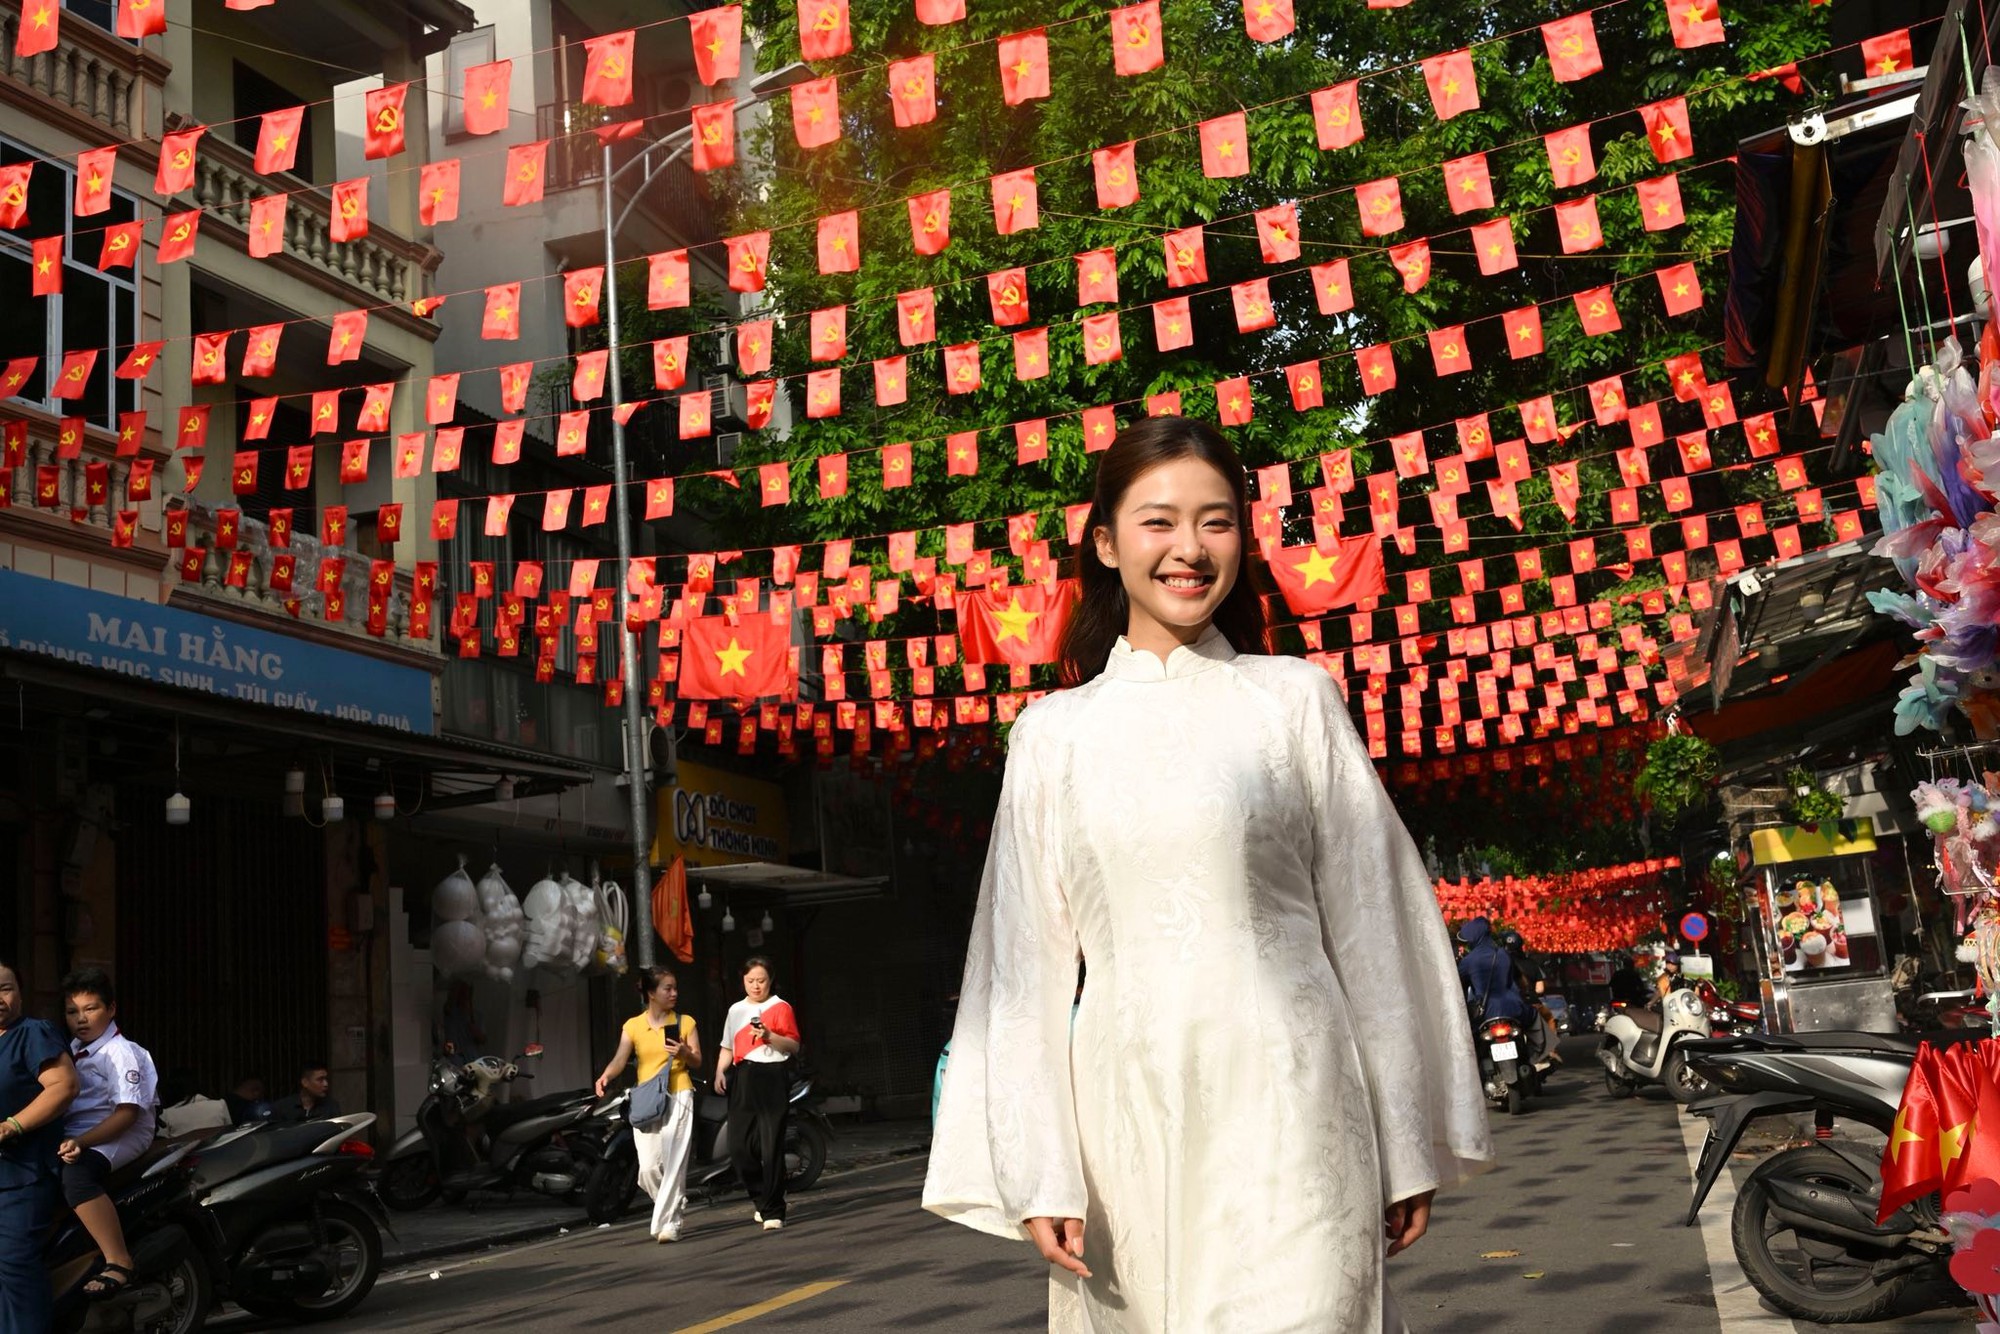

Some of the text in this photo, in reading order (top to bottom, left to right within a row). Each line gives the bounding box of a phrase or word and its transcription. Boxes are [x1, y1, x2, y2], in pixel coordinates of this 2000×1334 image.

[87, 612, 284, 681] MAI HẰNG
[159, 666, 214, 693] SINH
[235, 682, 267, 704] TÚI
[709, 827, 751, 853] THÔNG
